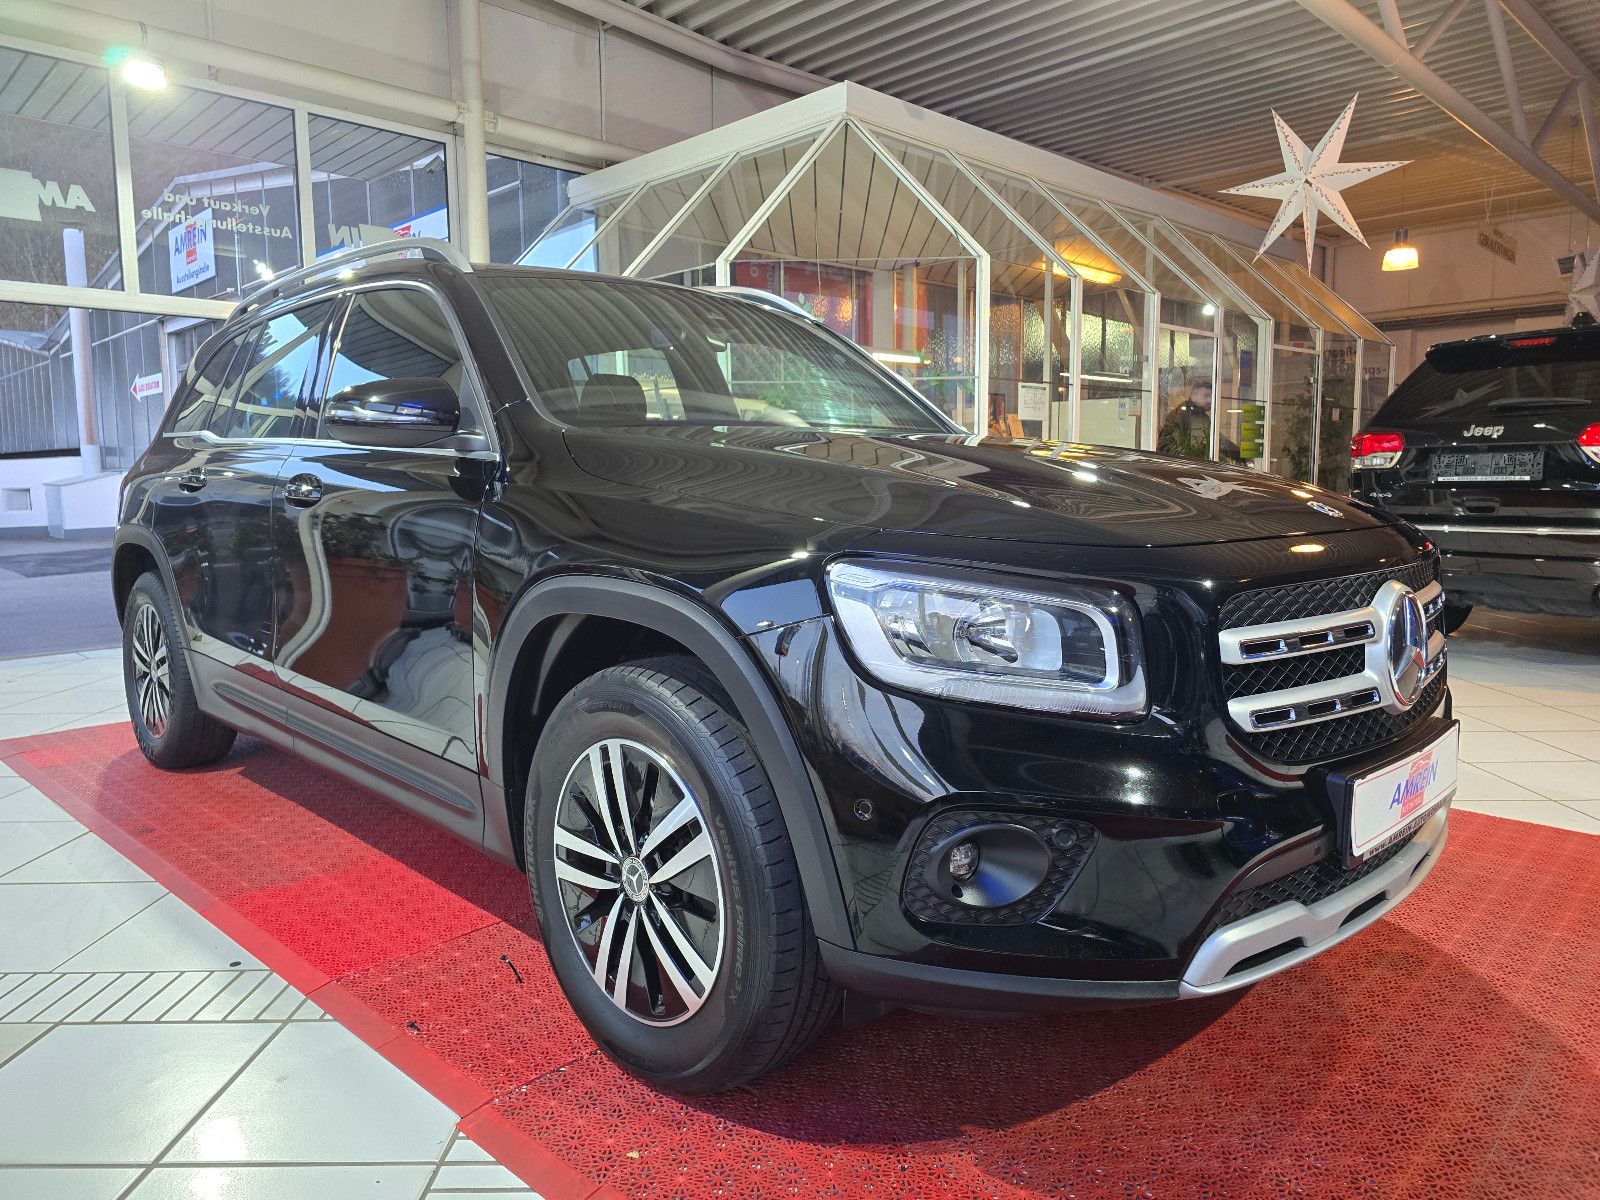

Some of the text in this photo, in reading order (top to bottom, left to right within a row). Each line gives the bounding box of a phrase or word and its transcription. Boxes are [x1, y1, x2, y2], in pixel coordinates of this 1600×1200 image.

[173, 220, 208, 257] AMREIN
[1463, 424, 1504, 439] Jeep
[1388, 758, 1439, 811] AMREIN
